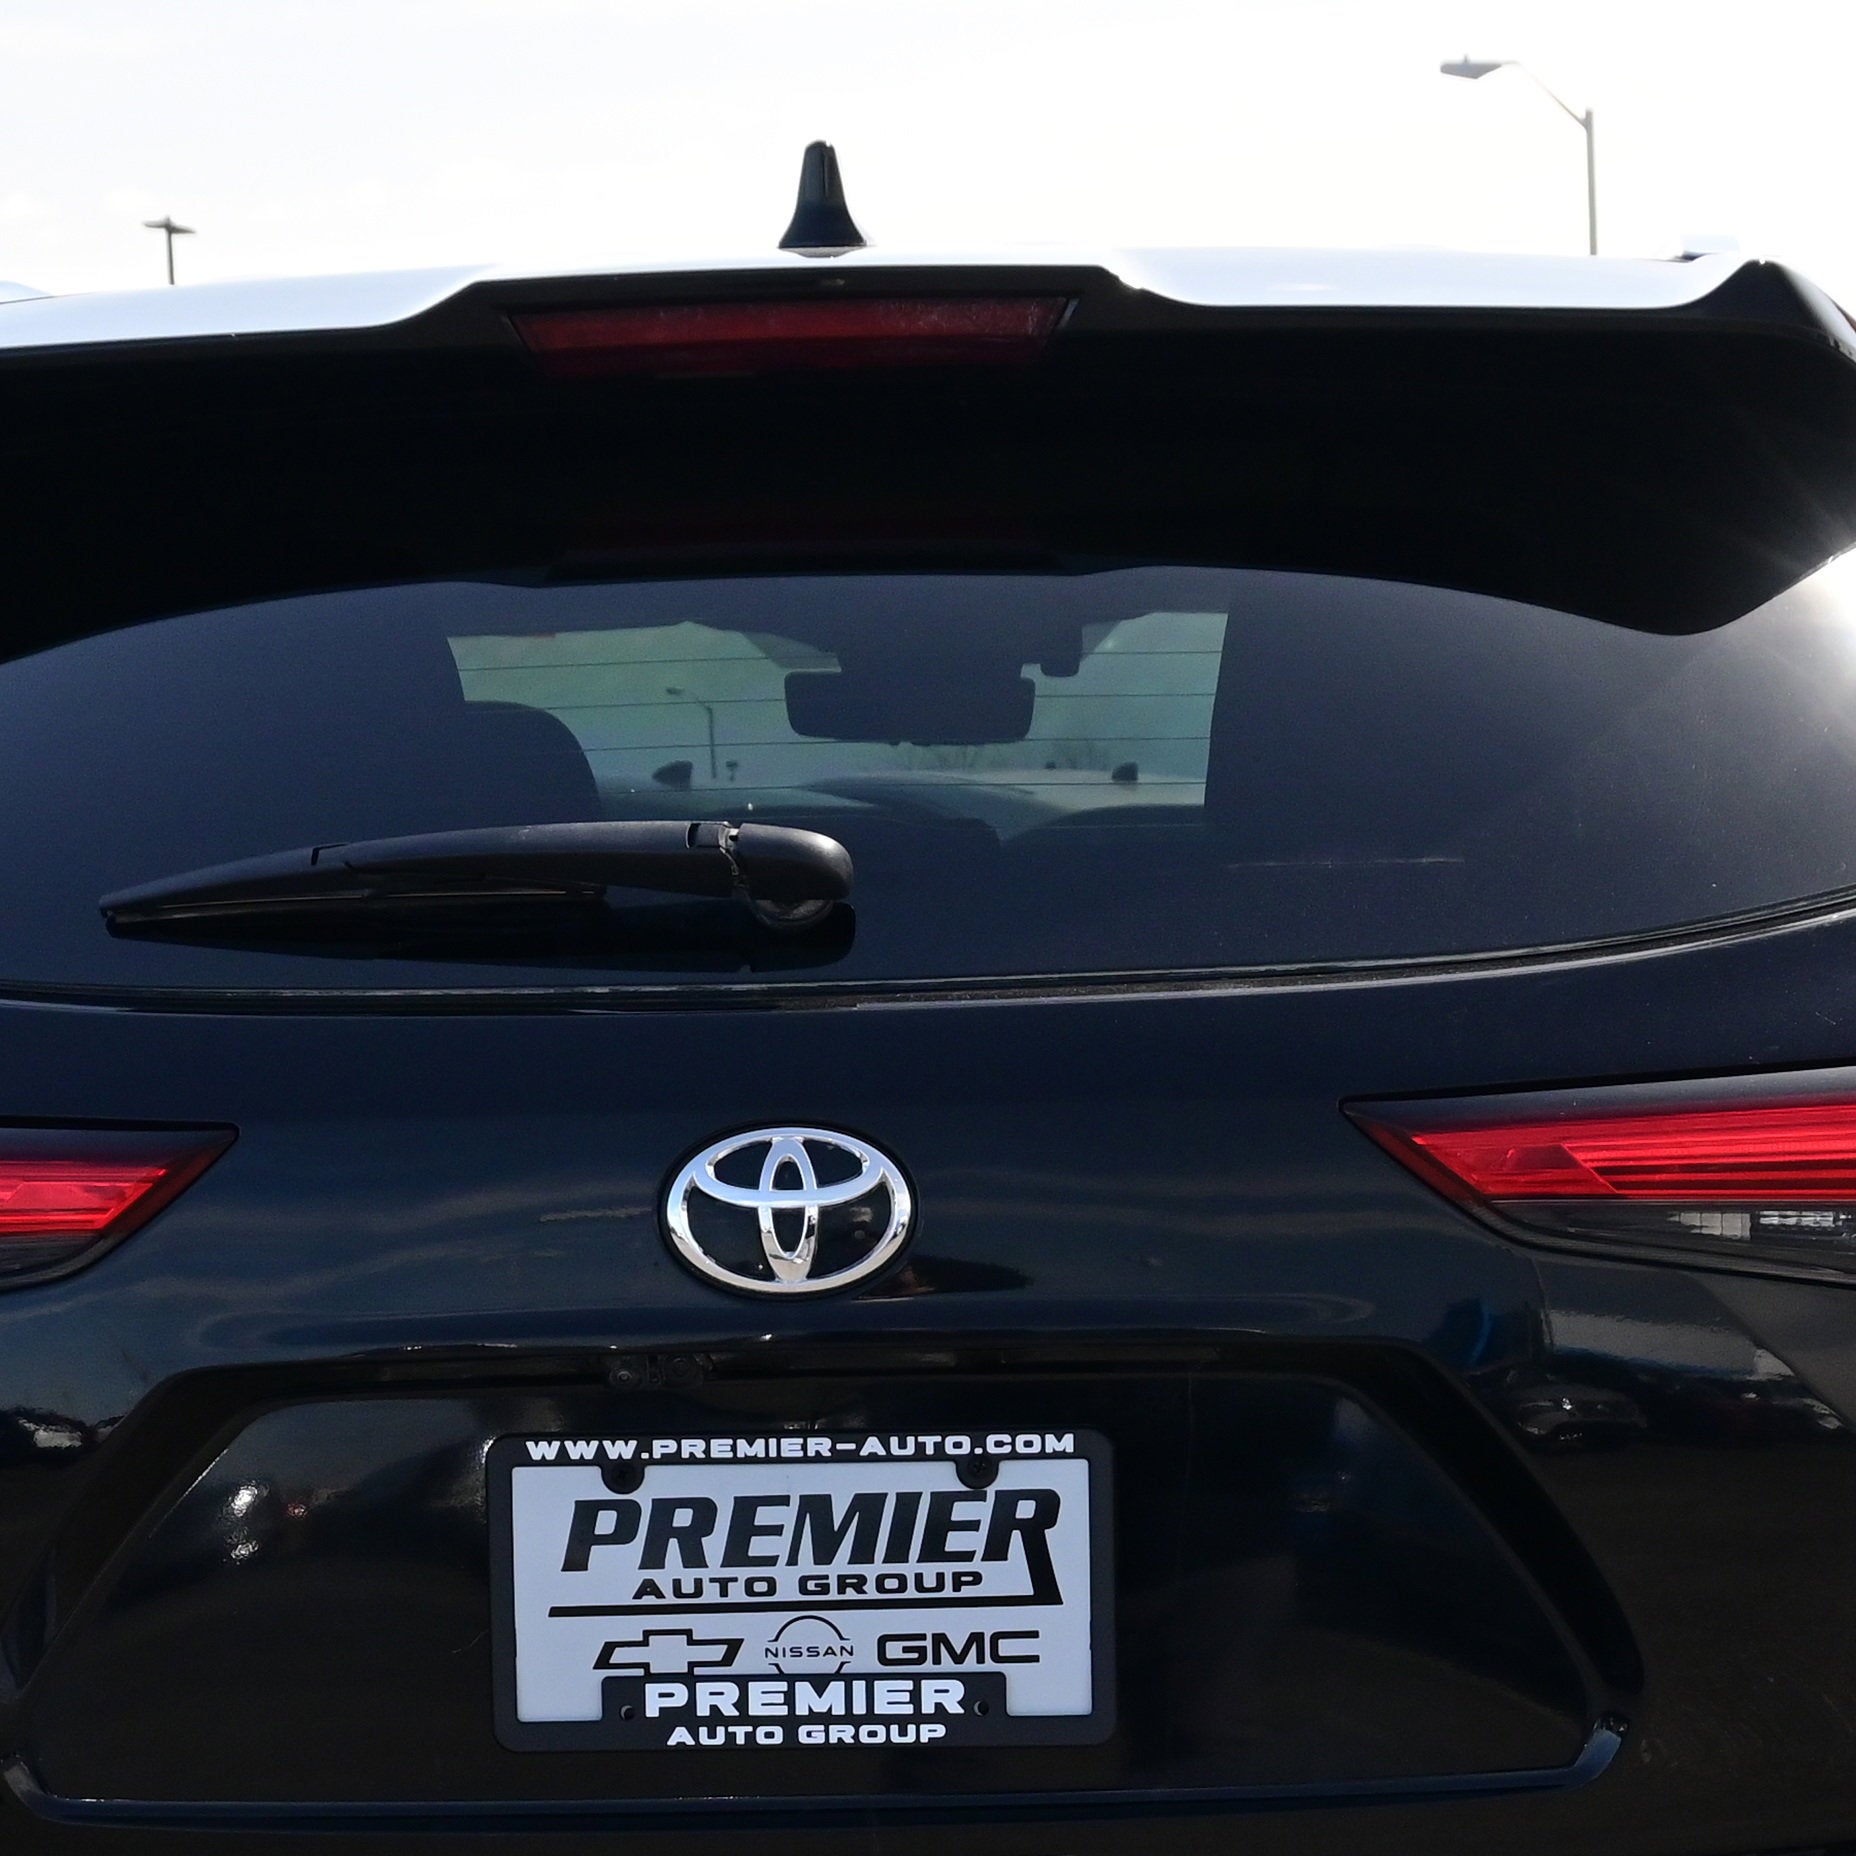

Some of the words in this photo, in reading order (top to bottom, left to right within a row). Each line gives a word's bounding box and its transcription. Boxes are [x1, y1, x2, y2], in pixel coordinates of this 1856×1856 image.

[525, 1432, 1076, 1461] WWW.PREMIER-AUTO.COM
[560, 1488, 1064, 1605] PREMIER
[632, 1575, 778, 1600] AUTO
[797, 1571, 985, 1597] GROUP
[764, 1644, 854, 1659] NISSAN
[876, 1629, 1041, 1667] GMC
[644, 1679, 965, 1719] PREMIER
[666, 1725, 785, 1746] AUTO
[796, 1723, 947, 1745] GROUP
